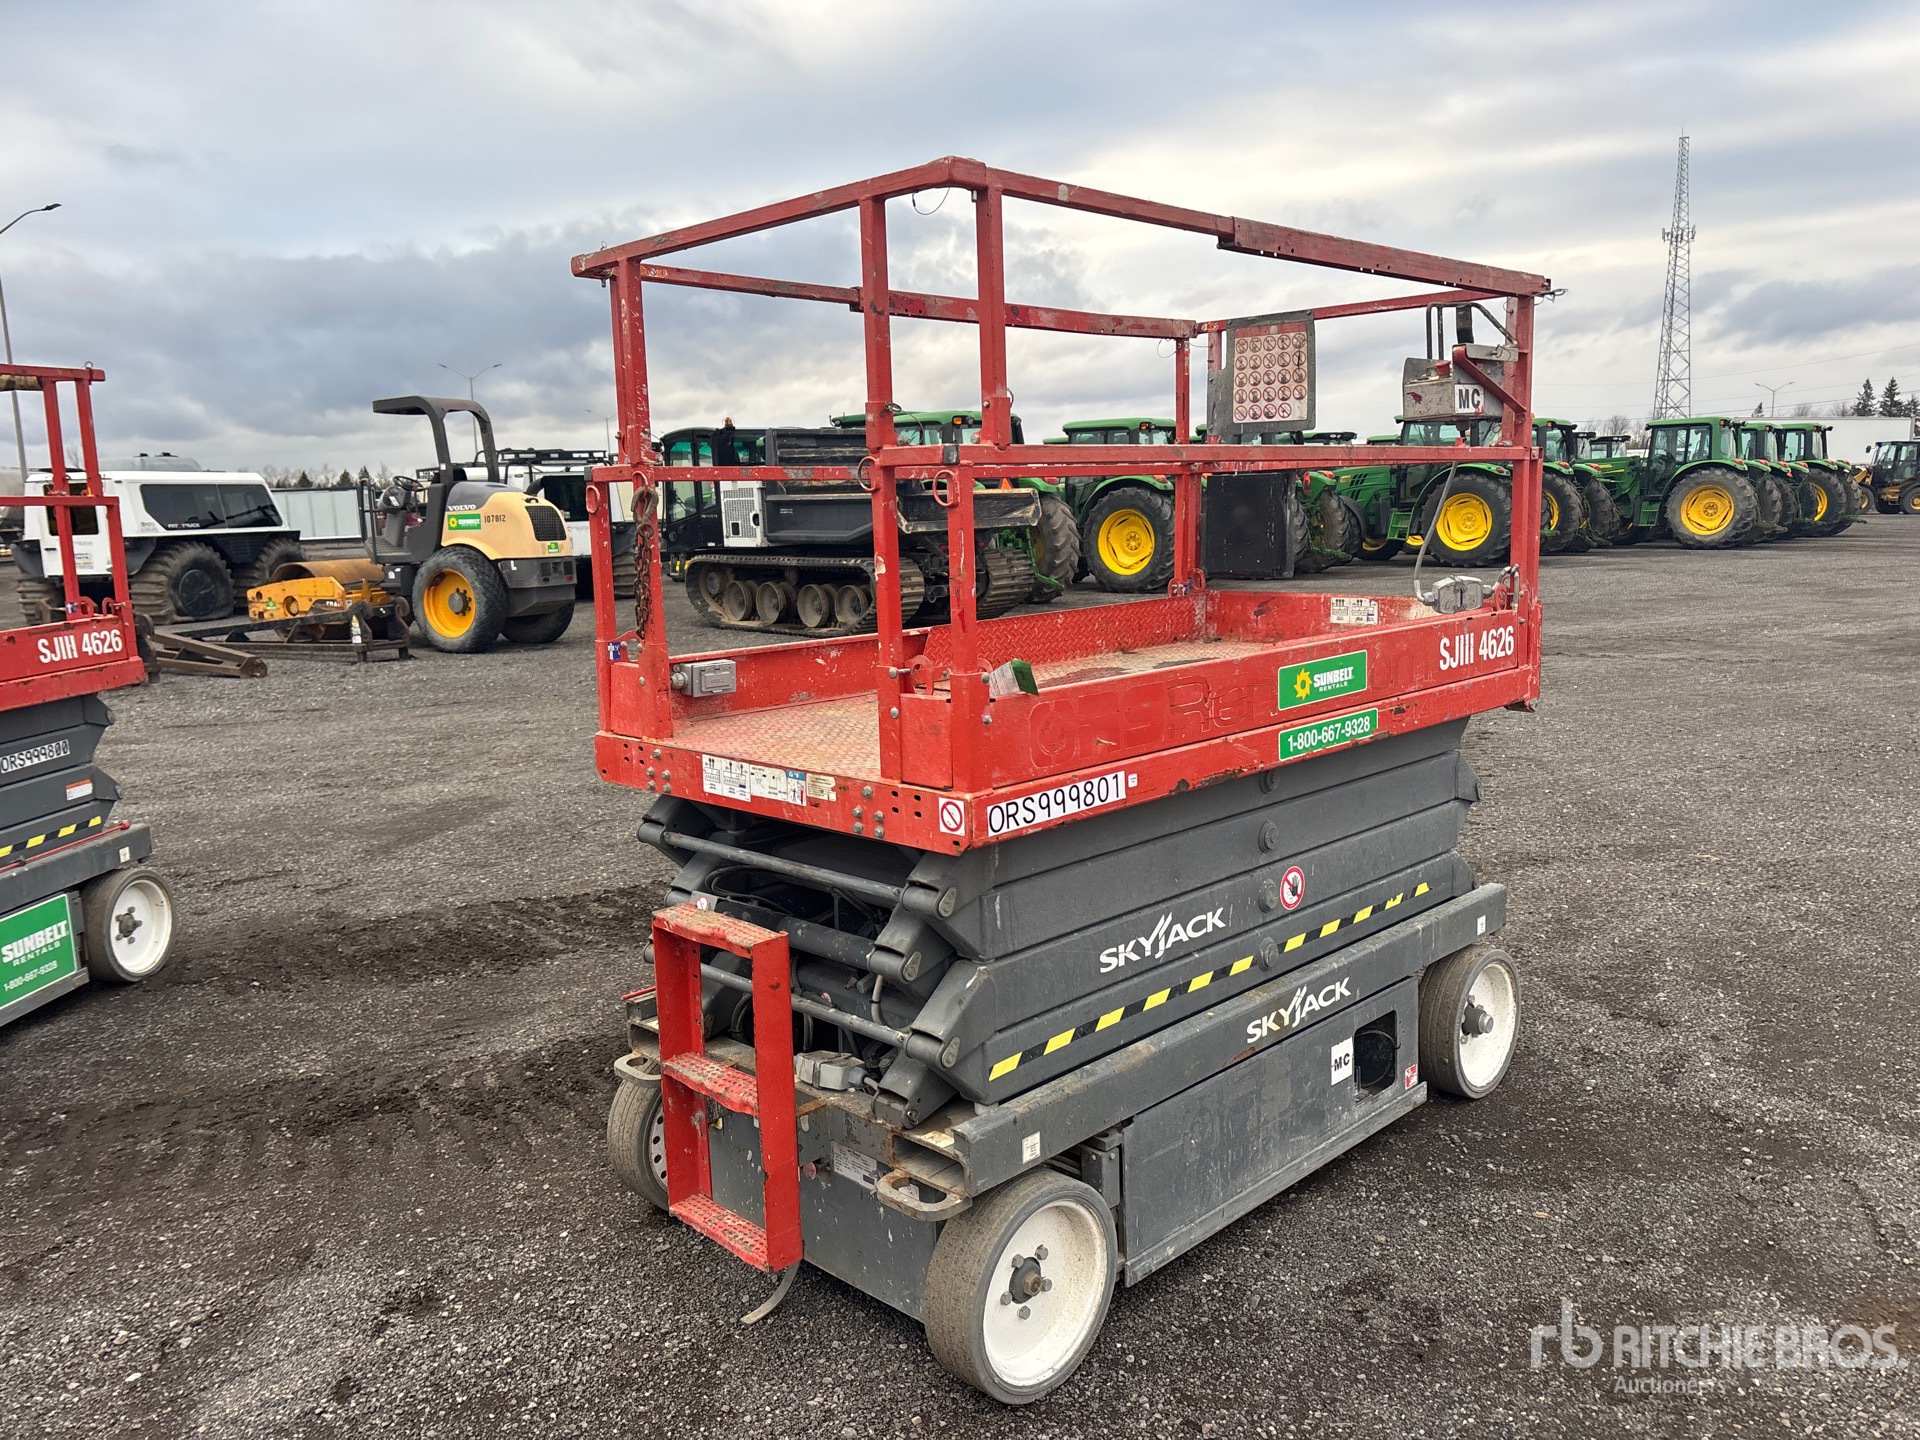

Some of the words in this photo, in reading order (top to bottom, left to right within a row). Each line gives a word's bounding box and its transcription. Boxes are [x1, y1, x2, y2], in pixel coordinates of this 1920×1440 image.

[1458, 388, 1481, 409] MC
[484, 514, 506, 524] 107812
[81, 629, 123, 657] 4626
[1439, 632, 1475, 671] SJIII
[1478, 625, 1515, 660] 4626
[1313, 666, 1354, 688] SUNBELT
[1318, 681, 1348, 693] RENTALS
[1287, 716, 1371, 753] 1-800-667-9328
[988, 773, 1120, 833] ORS999801
[1, 920, 68, 964] SUNBELT
[13, 940, 61, 967] RENTALS
[1099, 907, 1227, 974] SKYJACK
[1246, 977, 1352, 1044] SKYJACK
[1333, 1053, 1350, 1072] MC
